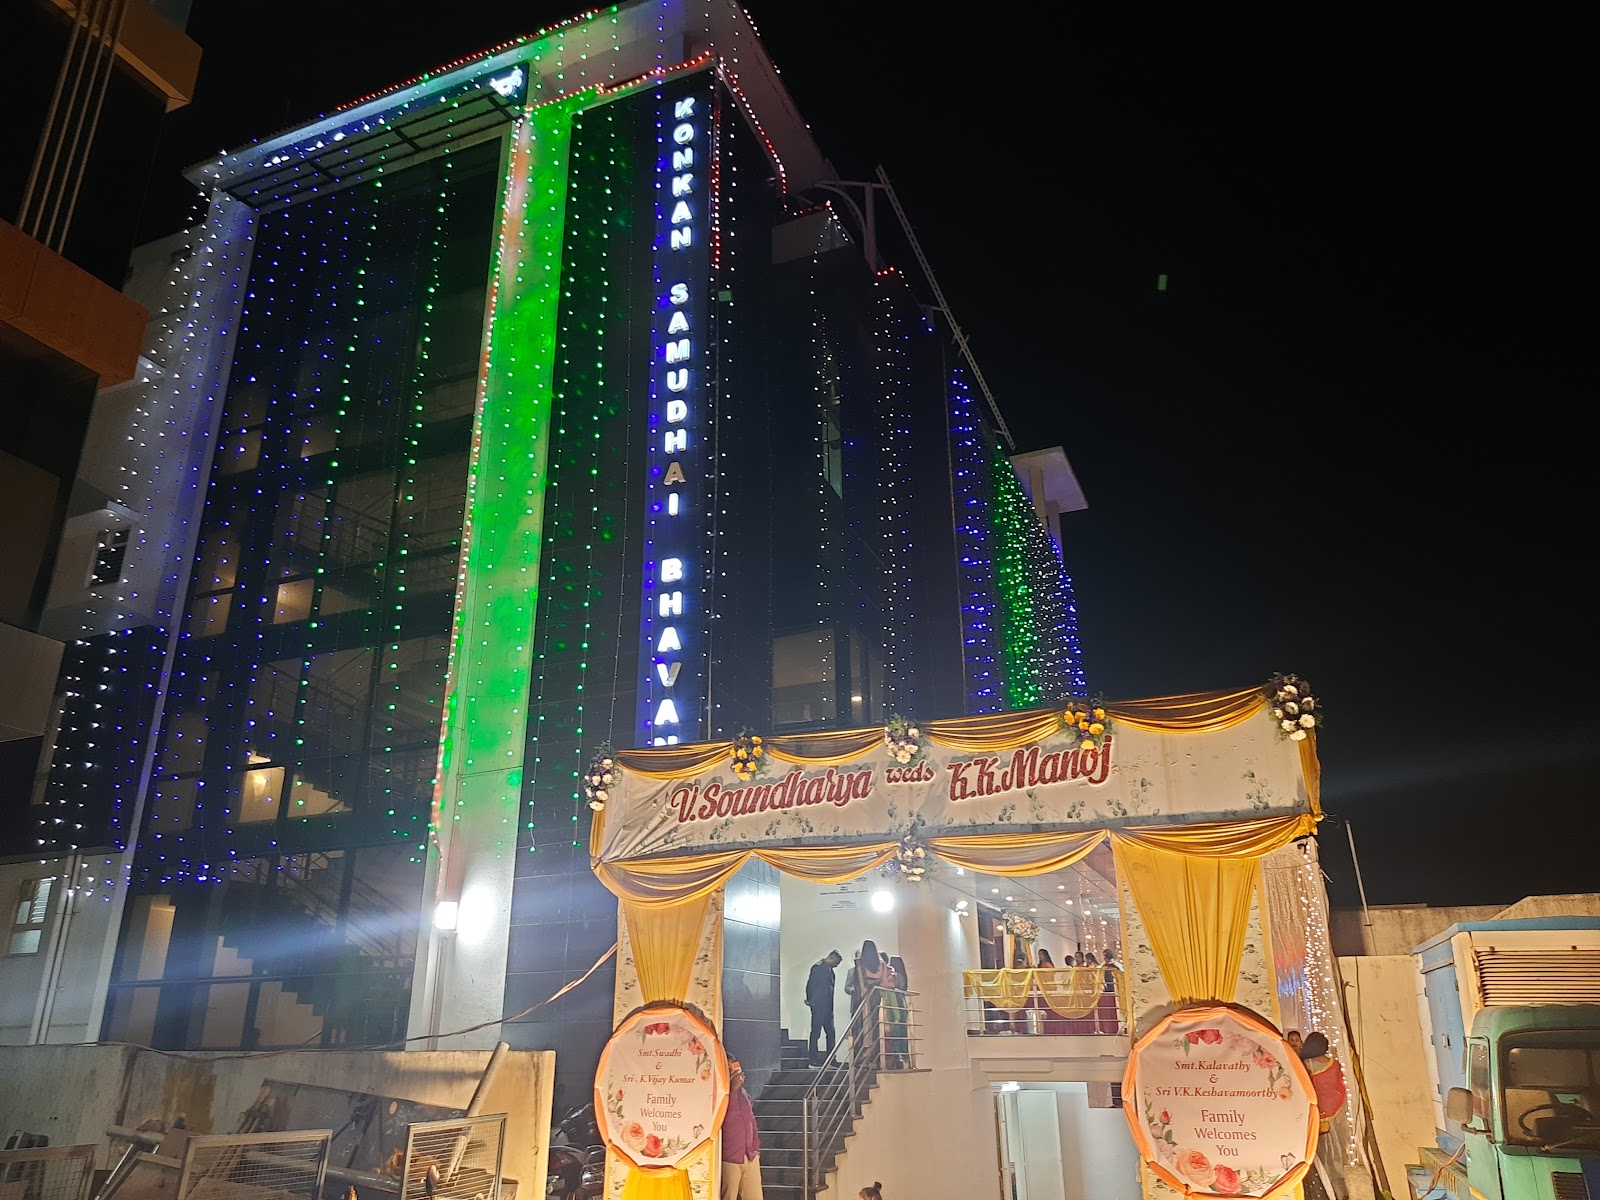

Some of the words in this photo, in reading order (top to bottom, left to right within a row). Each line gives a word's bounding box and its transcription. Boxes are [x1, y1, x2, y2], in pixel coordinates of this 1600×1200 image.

[671, 97, 695, 250] KONKAN
[664, 283, 690, 517] SAMUDHAI
[671, 769, 873, 823] V.Soundharya
[886, 760, 935, 783] weds
[947, 735, 1112, 801] K.K.Manoj
[655, 1061, 663, 1070] &
[668, 1074, 695, 1084] Kumar
[1209, 1073, 1219, 1084] &
[1155, 1086, 1171, 1096] Sri
[646, 1093, 677, 1107] Family
[640, 1107, 682, 1119] Welcomes
[1200, 1109, 1246, 1127] Family
[652, 1121, 667, 1132] You
[1193, 1127, 1257, 1141] Welcomes
[1215, 1144, 1239, 1157] You
